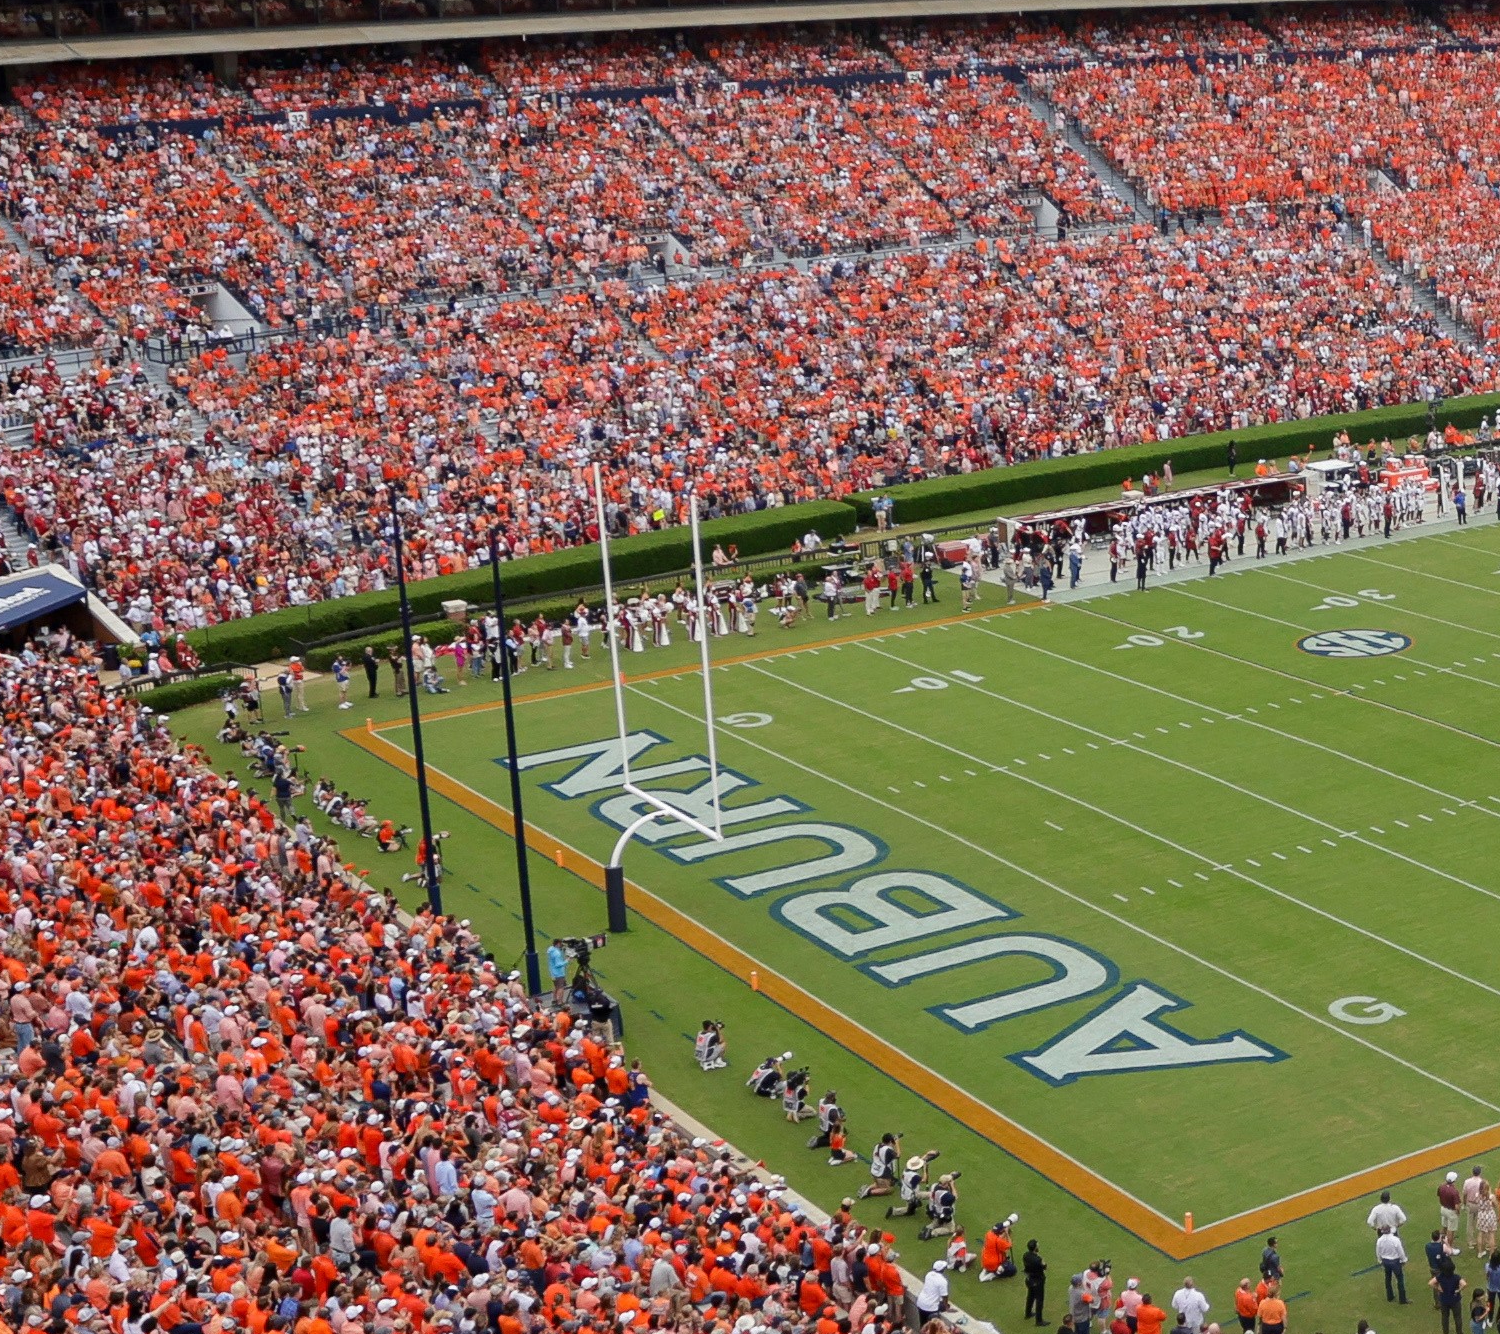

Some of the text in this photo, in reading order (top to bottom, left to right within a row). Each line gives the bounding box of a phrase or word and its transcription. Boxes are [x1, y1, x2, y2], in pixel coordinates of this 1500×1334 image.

[1323, 588, 1396, 608] 30
[1127, 625, 1205, 647] 20
[1299, 629, 1409, 657] SEC
[910, 669, 984, 690] 10
[717, 711, 773, 728] G
[494, 726, 1291, 1087] AUBURN
[1328, 995, 1408, 1025] G
